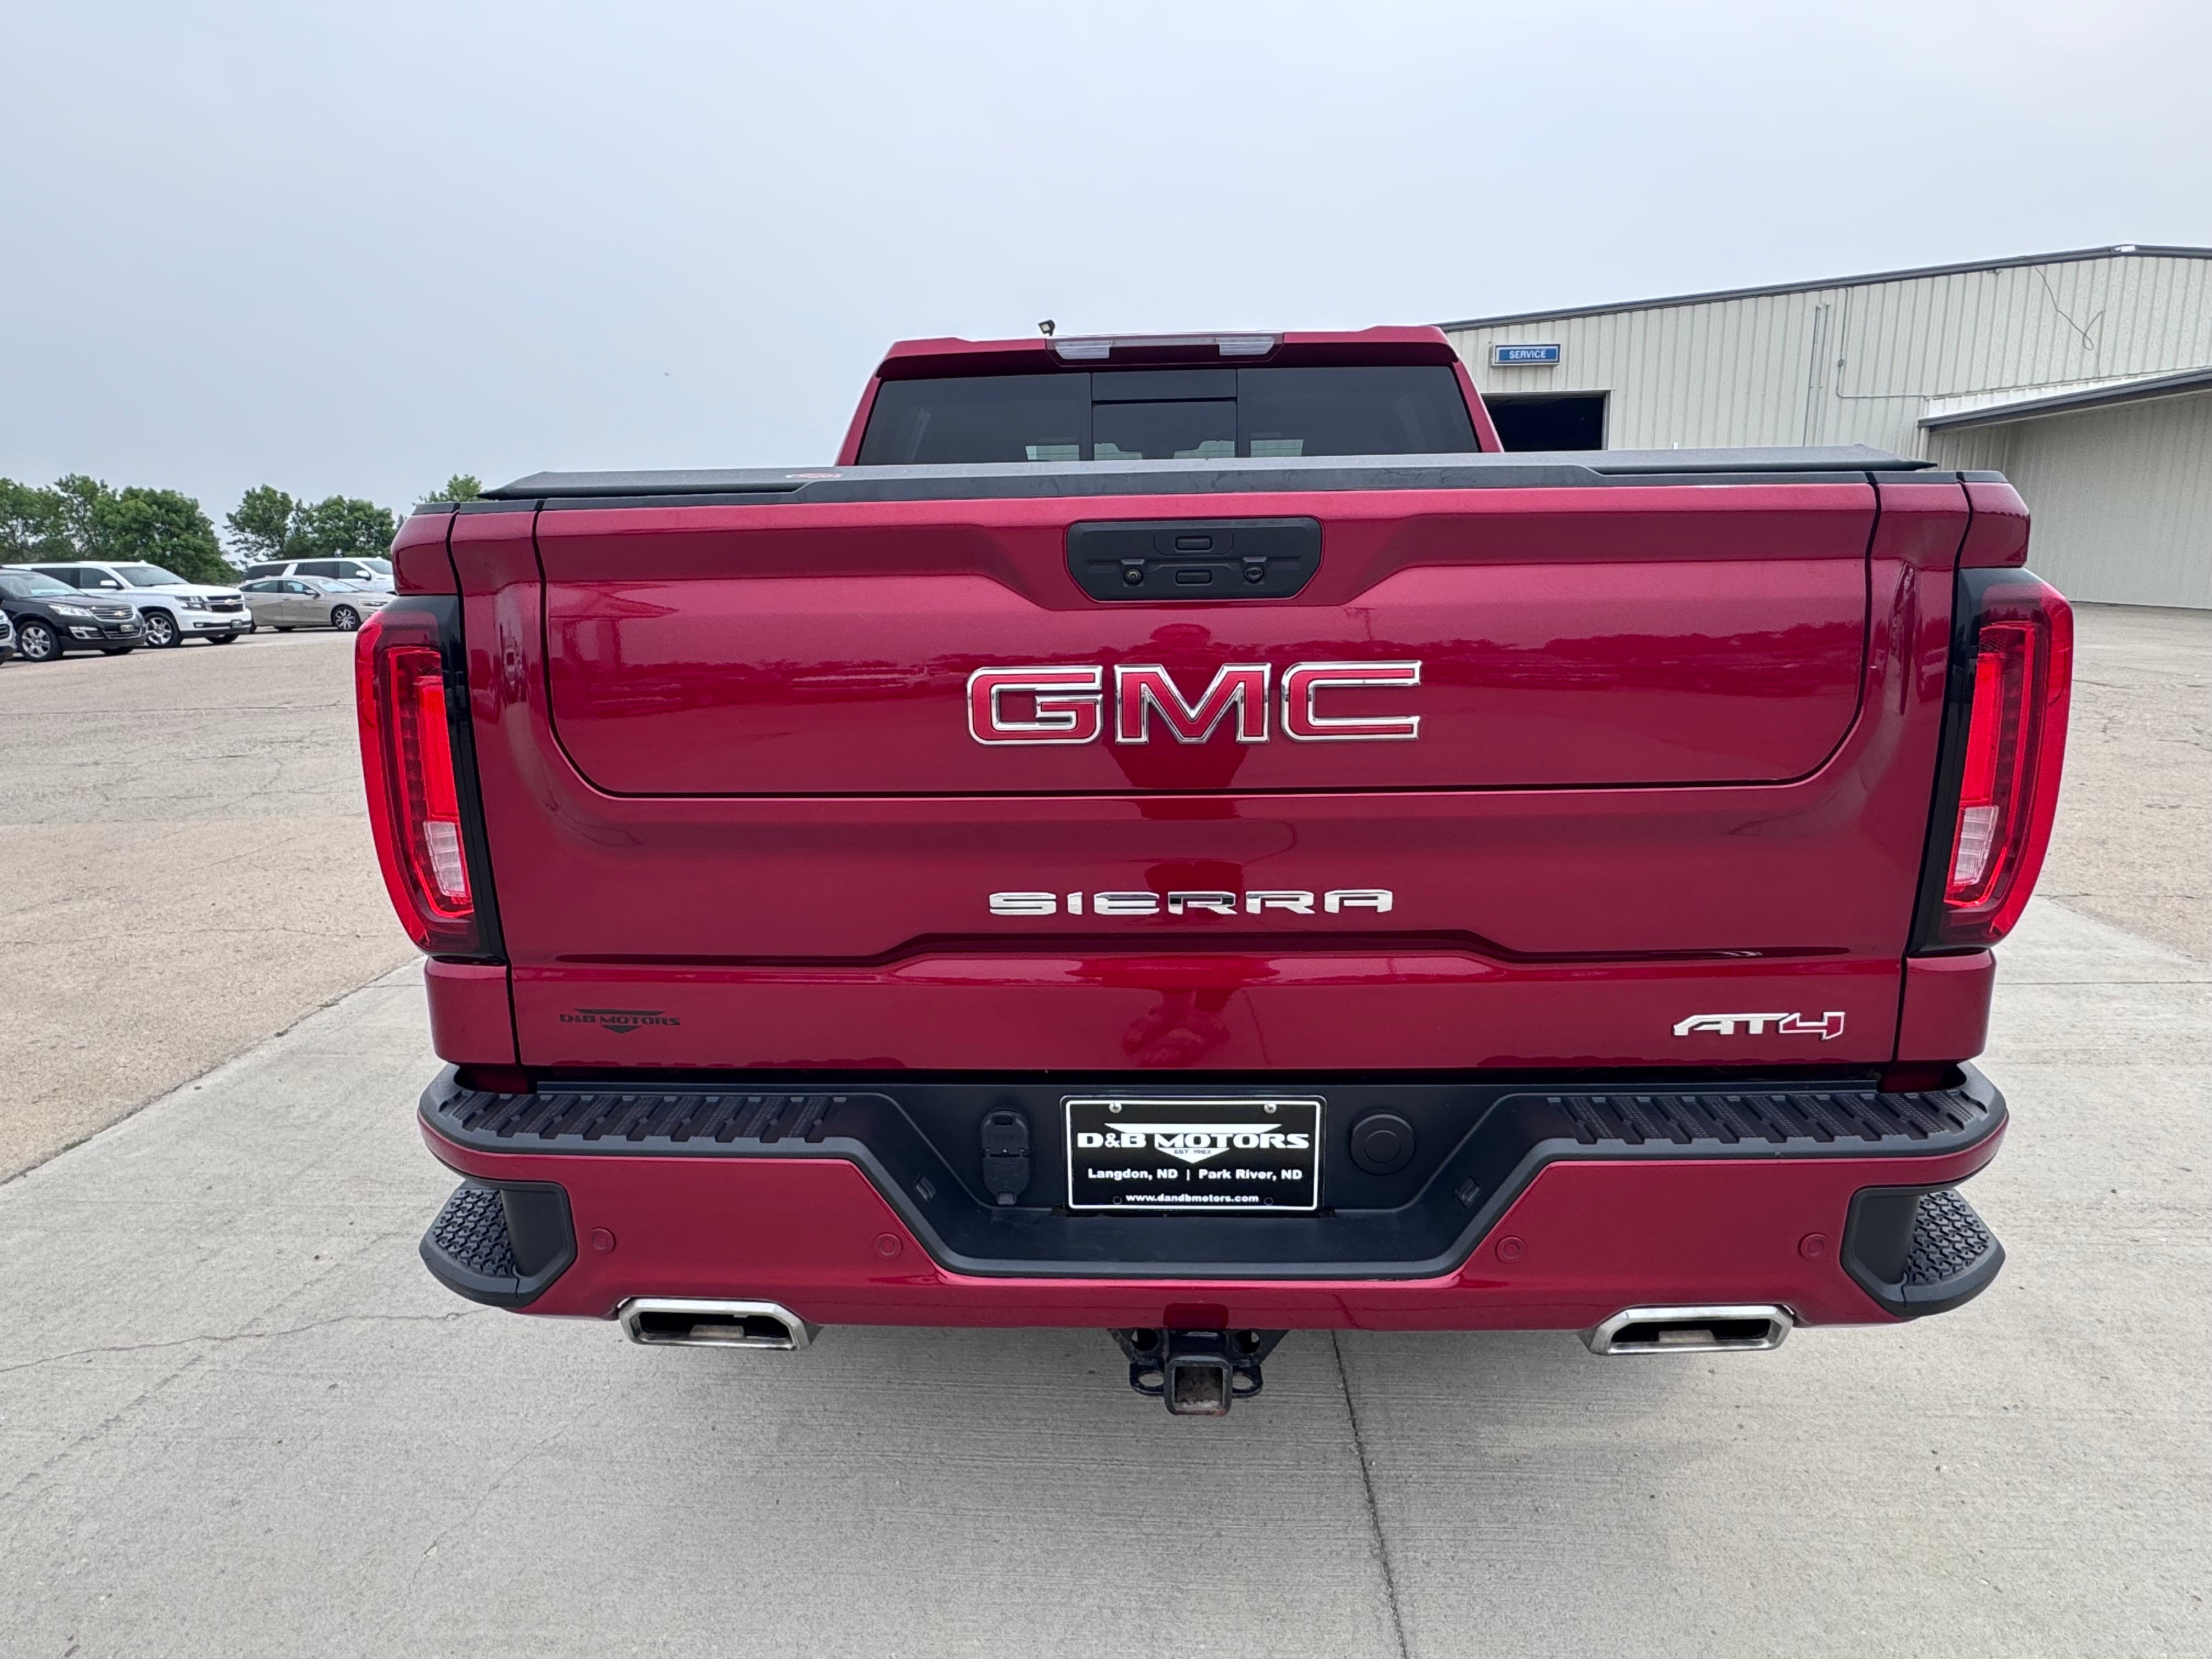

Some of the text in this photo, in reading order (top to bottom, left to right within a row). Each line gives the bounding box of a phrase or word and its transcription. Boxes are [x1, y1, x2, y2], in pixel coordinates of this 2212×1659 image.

[1509, 349, 1547, 359] SERVICE
[967, 659, 1423, 746] GMC
[989, 888, 1394, 916] SIERRA
[559, 1014, 680, 1026] D&B MOTORS
[1673, 1011, 1846, 1041] AT4
[1077, 1132, 1310, 1149] D&B MOTORS
[1088, 1168, 1303, 1181] Langdon, ND Park River, ND
[1125, 1193, 1259, 1203] www.dandbmotors.com
